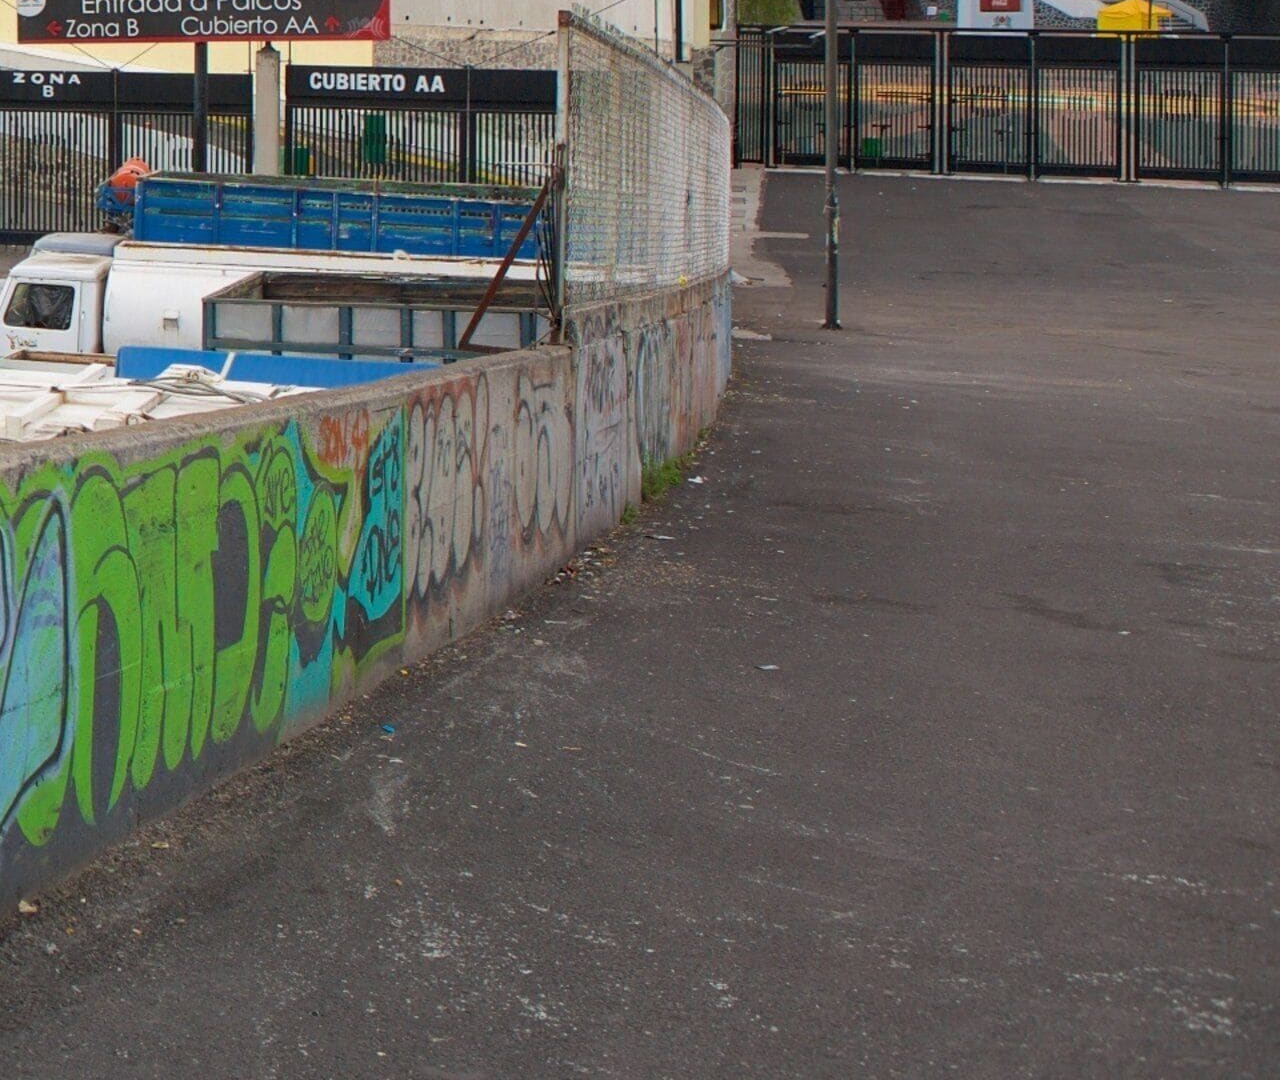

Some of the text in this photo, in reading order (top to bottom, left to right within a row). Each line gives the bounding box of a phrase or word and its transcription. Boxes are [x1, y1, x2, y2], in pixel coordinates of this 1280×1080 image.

[65, 19, 140, 38] Zona B
[180, 16, 319, 36] Cubierto AA
[13, 72, 81, 85] ZONA
[309, 71, 445, 93] CUBIERTO AA
[42, 84, 54, 98] B
